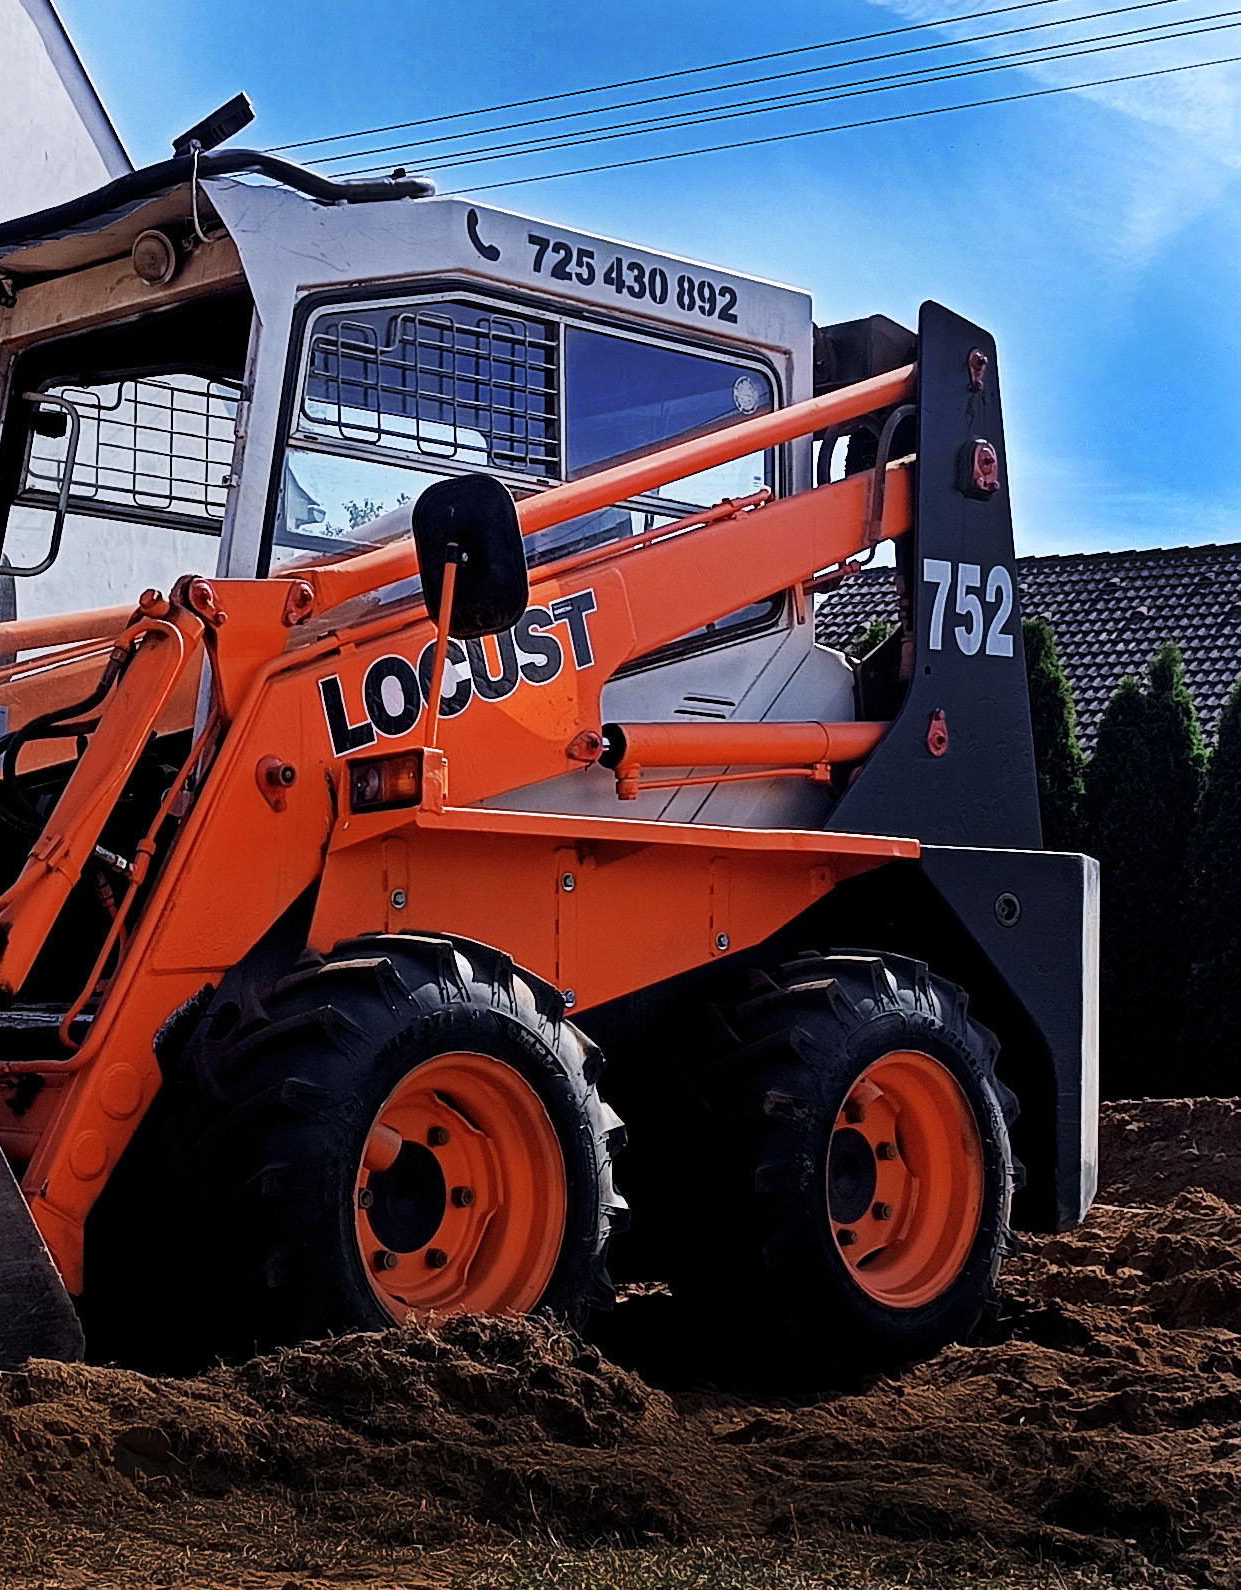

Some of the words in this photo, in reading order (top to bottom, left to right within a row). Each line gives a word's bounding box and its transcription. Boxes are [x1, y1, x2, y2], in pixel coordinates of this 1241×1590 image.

[527, 233, 596, 286] 725
[603, 256, 669, 305] 430
[676, 274, 738, 324] 892
[923, 558, 1014, 658] 752
[318, 587, 598, 758] LOCUST
